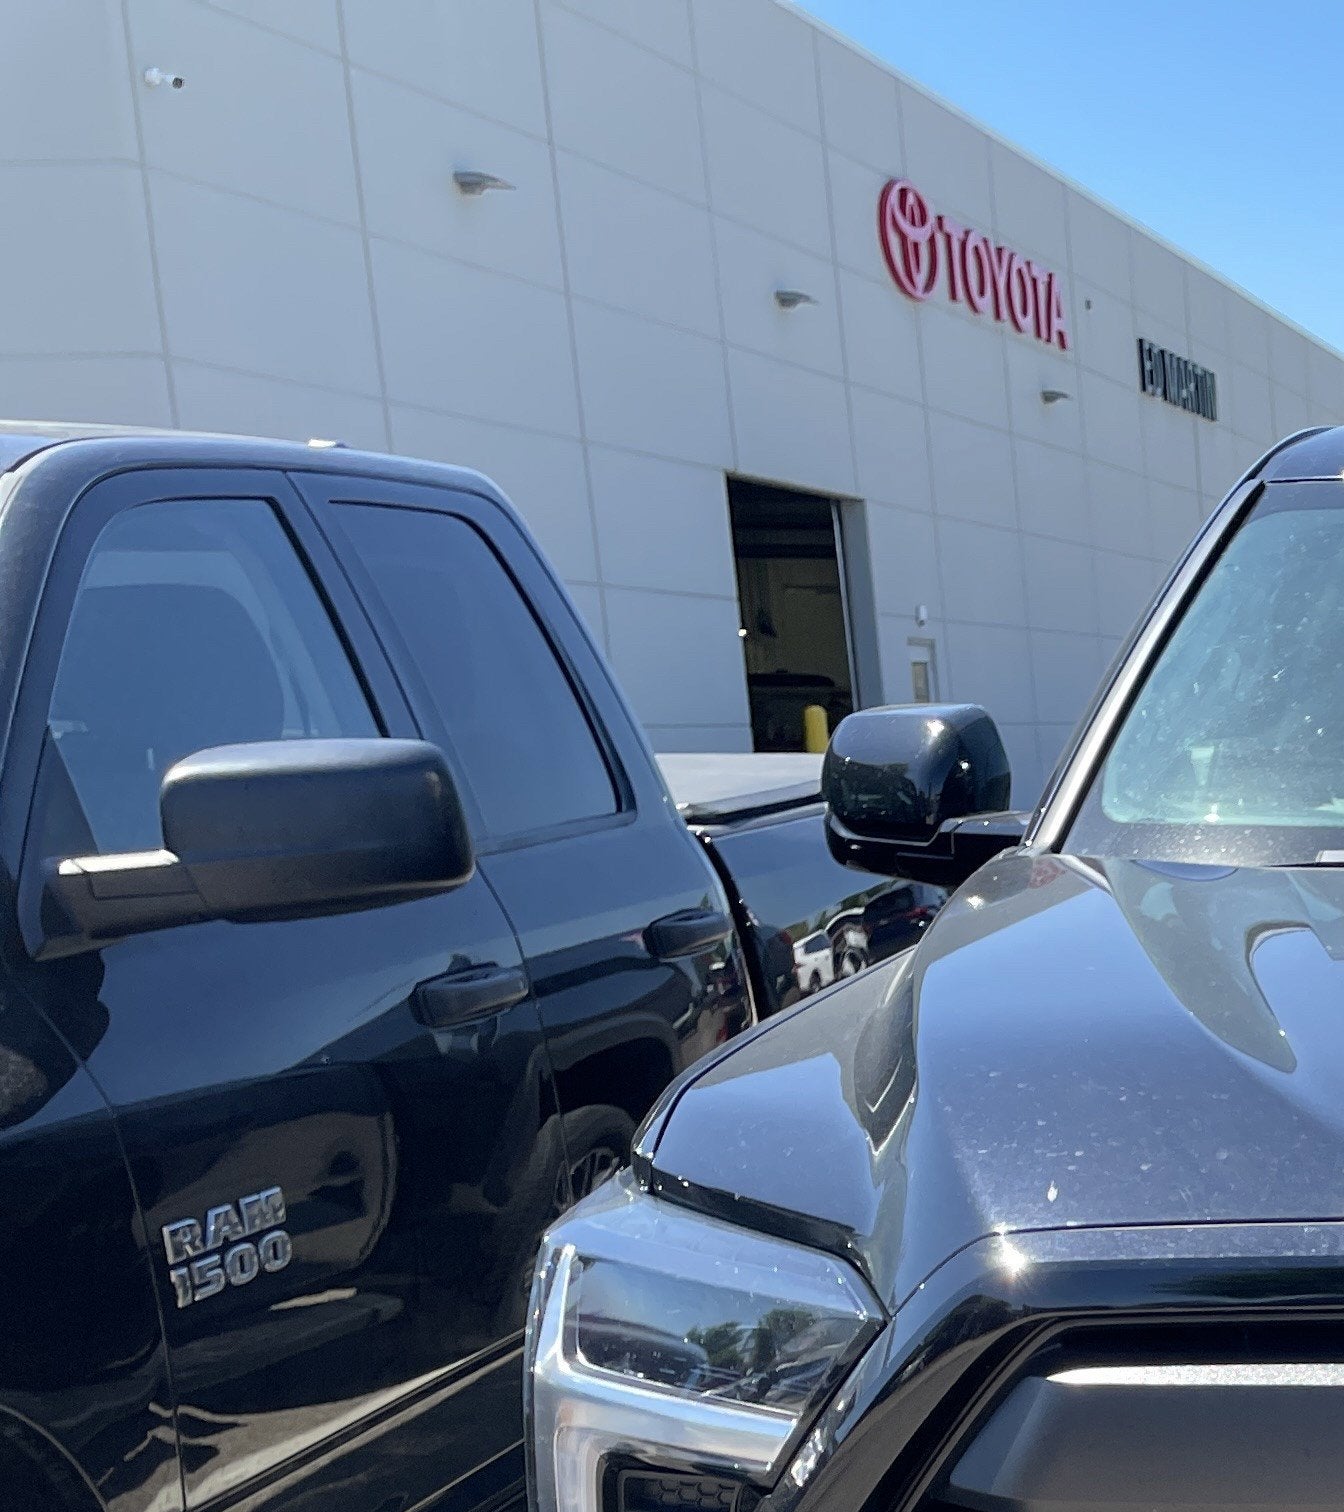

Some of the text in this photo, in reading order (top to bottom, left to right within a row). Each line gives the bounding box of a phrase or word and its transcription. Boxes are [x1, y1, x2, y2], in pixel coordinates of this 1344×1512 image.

[935, 214, 1069, 352] TOYOTA
[161, 1185, 287, 1266] RAM
[169, 1229, 293, 1309] 1500
